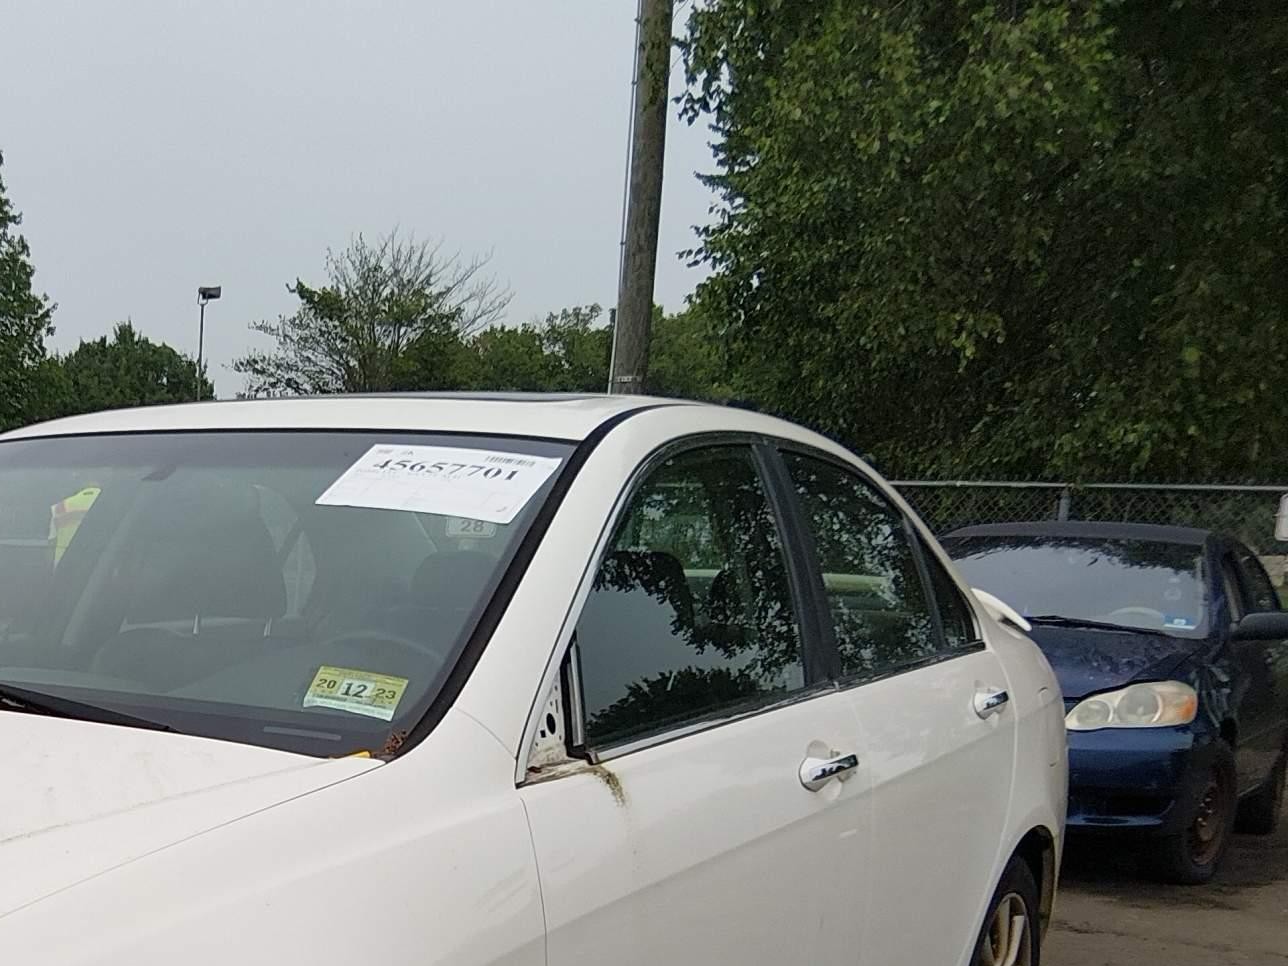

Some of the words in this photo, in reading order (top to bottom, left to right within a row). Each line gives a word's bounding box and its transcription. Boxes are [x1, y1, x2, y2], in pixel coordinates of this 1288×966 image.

[372, 459, 519, 481] 45657701
[461, 519, 485, 533] 28
[316, 678, 338, 690] 20
[341, 682, 368, 699] 12
[373, 687, 397, 701] 23
